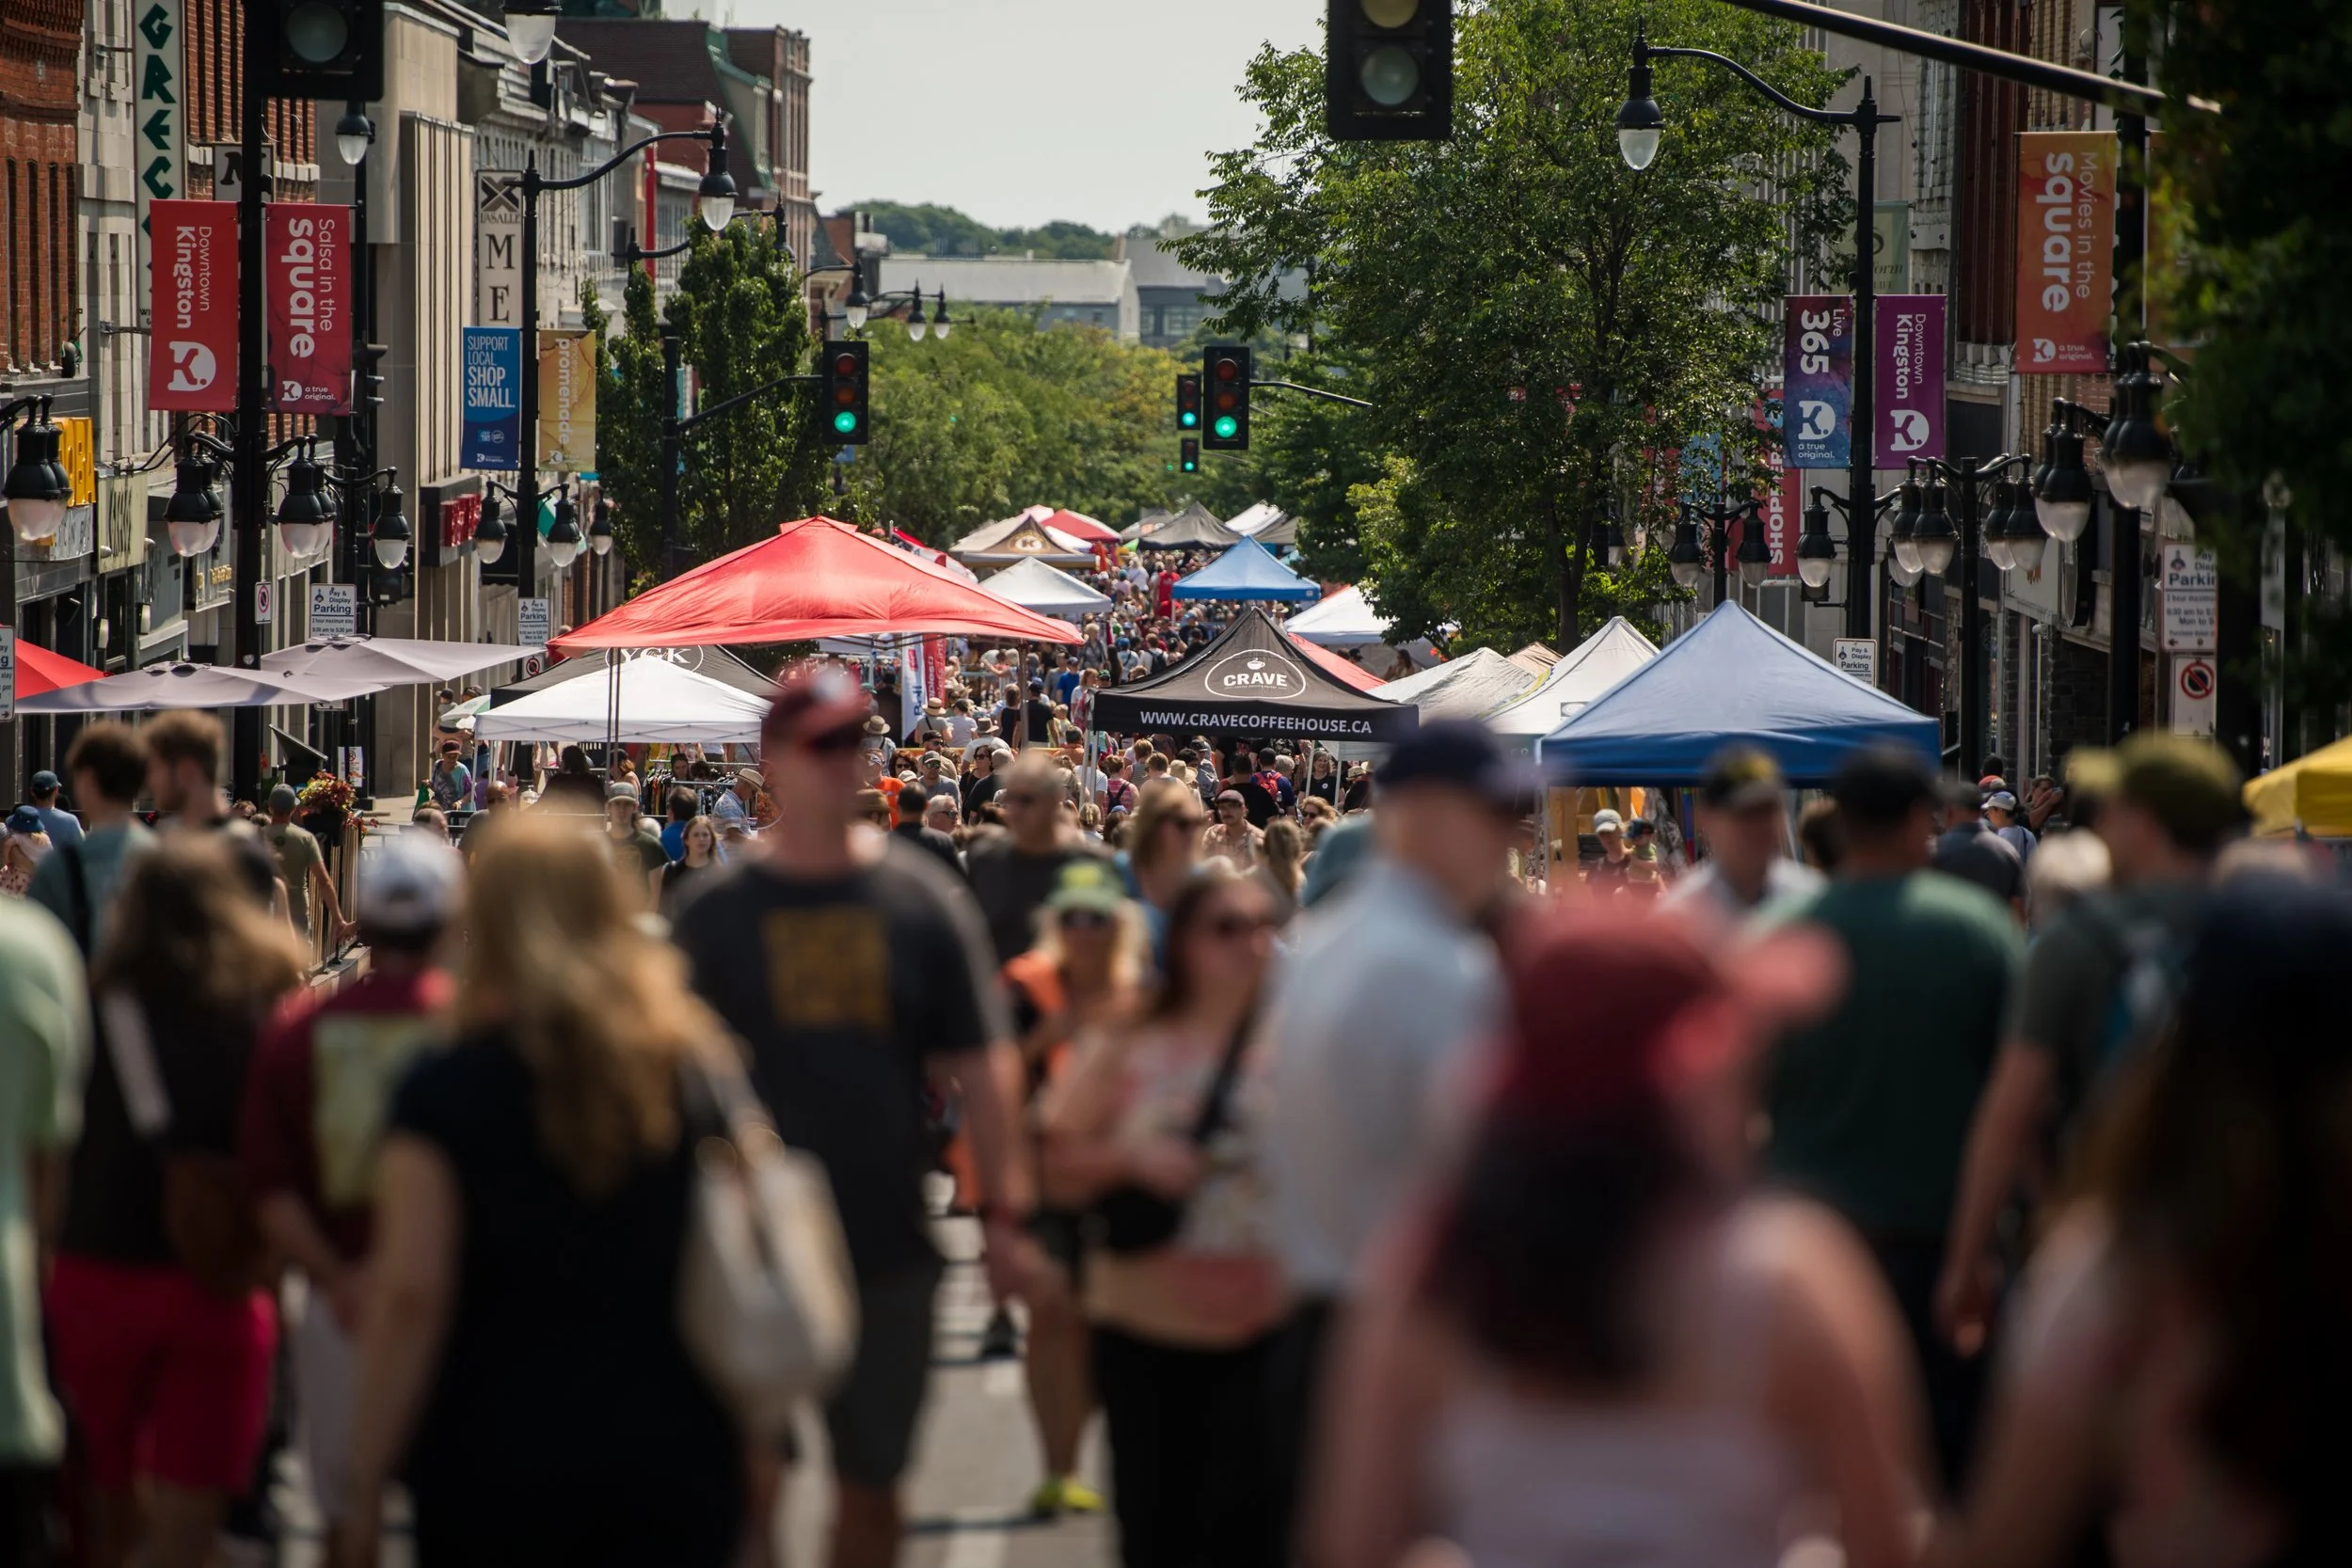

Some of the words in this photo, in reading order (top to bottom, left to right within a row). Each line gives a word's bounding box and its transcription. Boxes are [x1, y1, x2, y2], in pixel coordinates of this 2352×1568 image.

[2077, 151, 2098, 230] Movies
[318, 218, 336, 271] Salsa
[2036, 151, 2074, 312] square
[2076, 235, 2097, 254] in
[172, 226, 198, 329] Kingston
[199, 226, 213, 311] Downtown
[2076, 261, 2095, 298] the
[280, 217, 315, 358] square
[319, 277, 337, 293] in
[319, 299, 337, 331] the
[1833, 309, 1846, 338] Live
[467, 335, 509, 351] SUPPORT
[1800, 309, 1831, 375] 365
[1893, 313, 1914, 400] Kingston
[1914, 313, 1927, 385] Downtown
[468, 351, 497, 366] LOCAL
[468, 366, 506, 387] SHOP
[468, 388, 516, 408] SMALL.
[555, 338, 573, 445] promenade
[1806, 442, 1826, 451] true
[314, 604, 352, 614] Parking
[520, 612, 547, 621] Parking
[1223, 672, 1288, 687] CRAVE
[1840, 661, 1869, 670] Parking
[1139, 710, 1373, 735] WWW.CRAVECOFFEEHOUSE.CA
